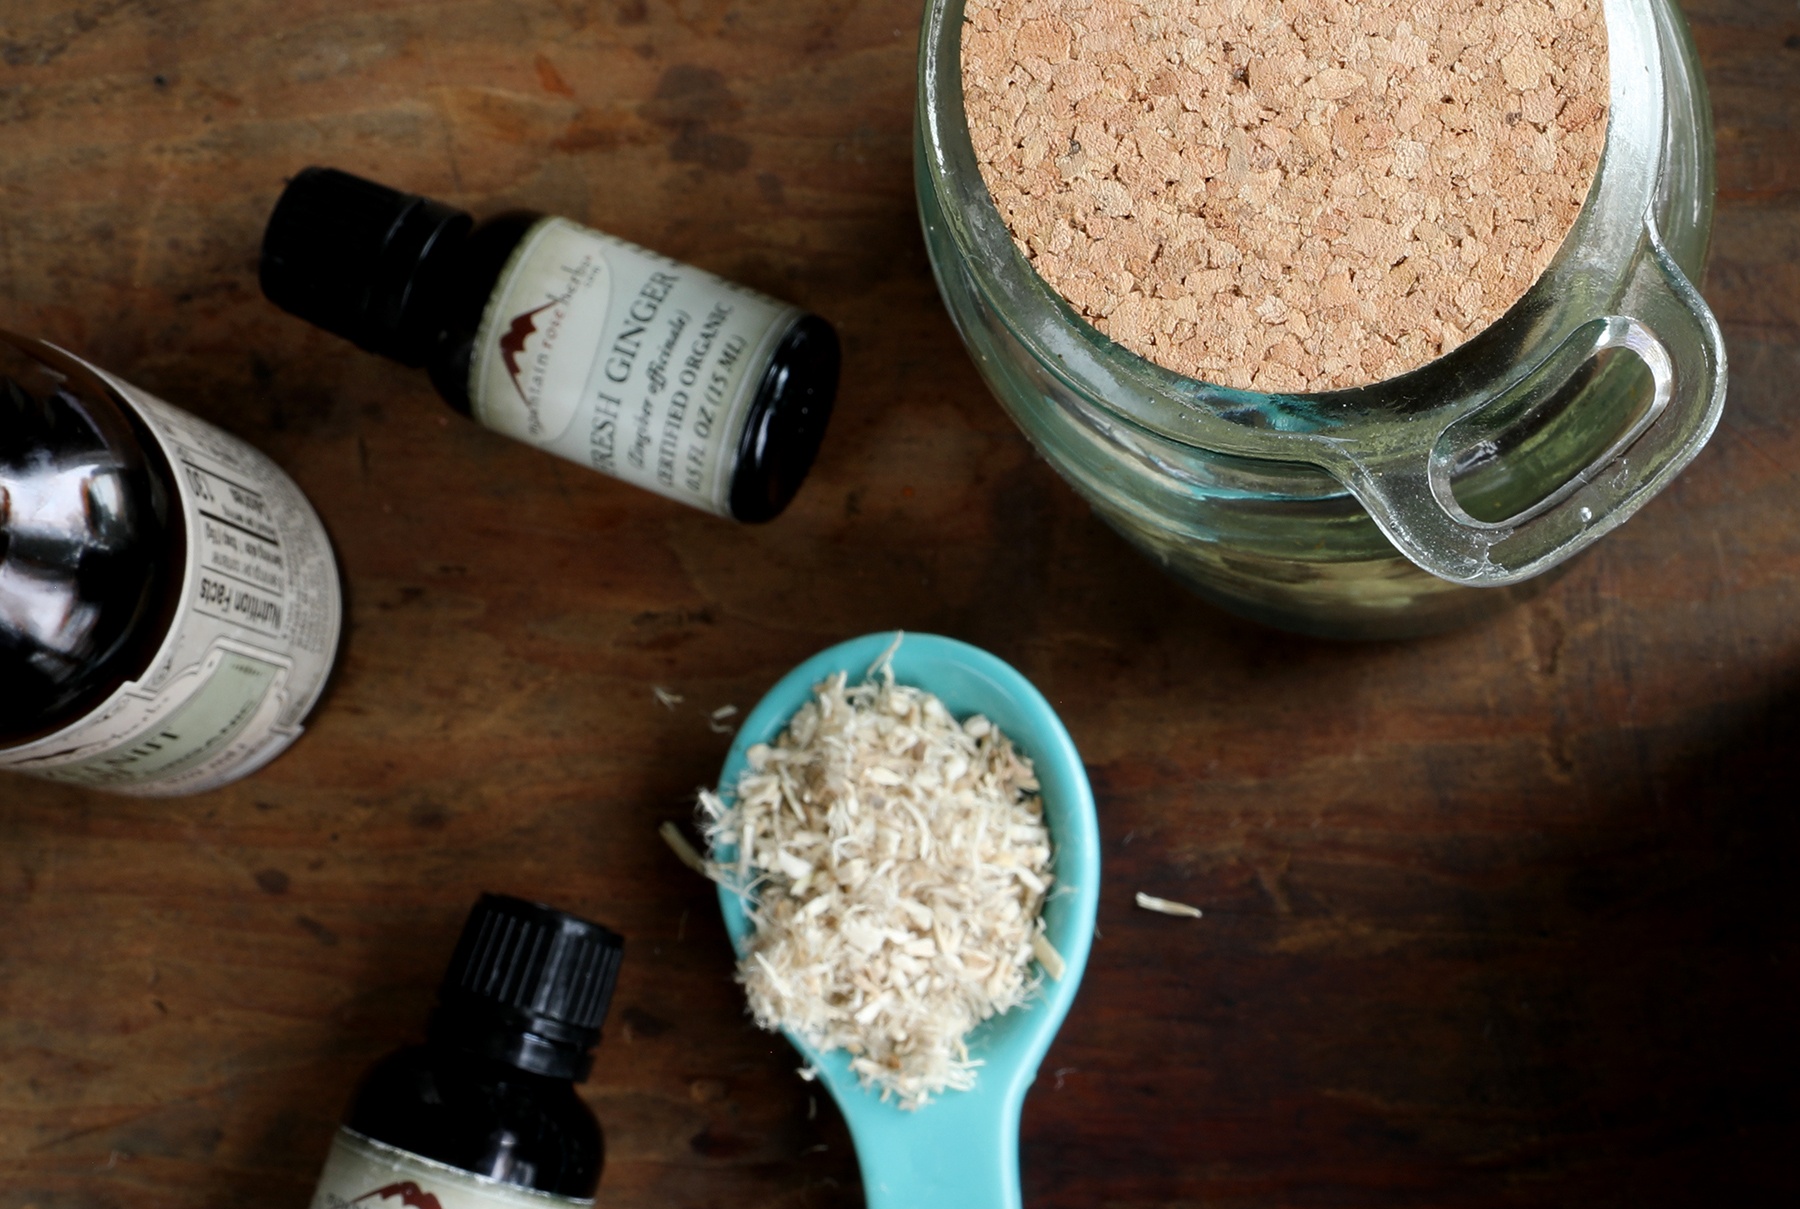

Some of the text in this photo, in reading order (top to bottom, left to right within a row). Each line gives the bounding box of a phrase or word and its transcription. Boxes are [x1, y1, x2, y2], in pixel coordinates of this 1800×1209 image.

[541, 308, 564, 350] rose
[604, 270, 681, 381] GINGER
[646, 308, 692, 394] officinale)
[714, 334, 749, 374] ML)
[655, 299, 732, 485] CERTIFIED ORGANIC
[704, 371, 729, 405] (15
[589, 391, 621, 474] FRESH
[691, 403, 714, 438] OZ
[686, 441, 705, 468] FL
[198, 578, 278, 628] Nutrition Facts
